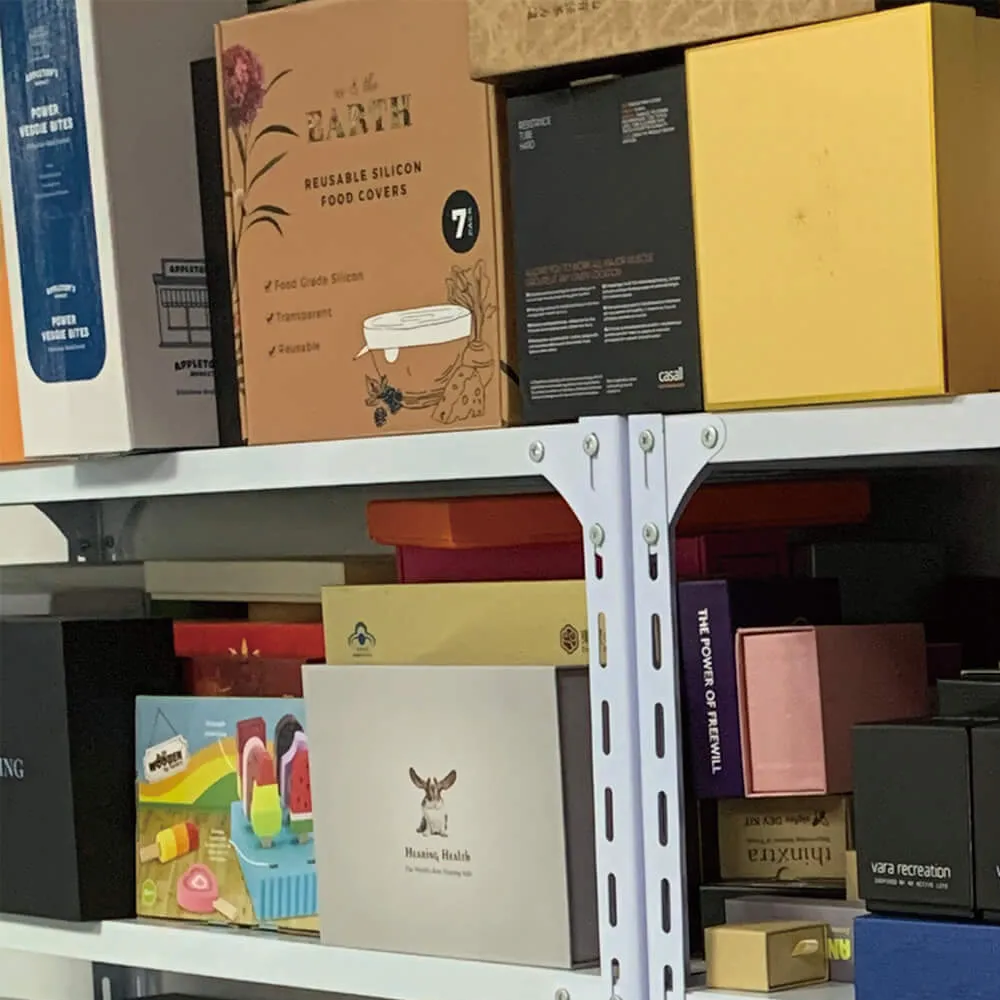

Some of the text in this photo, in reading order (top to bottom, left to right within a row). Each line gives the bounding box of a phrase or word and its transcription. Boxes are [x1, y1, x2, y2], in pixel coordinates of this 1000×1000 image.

[31, 103, 60, 119] POWER
[305, 93, 413, 143] EARTH
[19, 117, 74, 138] VEGGIE BITES
[304, 160, 423, 191] REUSABLE SILICON
[321, 184, 407, 207] FOOD COVERS
[451, 207, 467, 239] 7
[51, 314, 77, 327] POWER
[276, 307, 332, 322] Transparent
[697, 608, 723, 776] THE POWER OF FREEWILL
[747, 847, 831, 867] thinxtra
[871, 861, 952, 879] vara recreation
